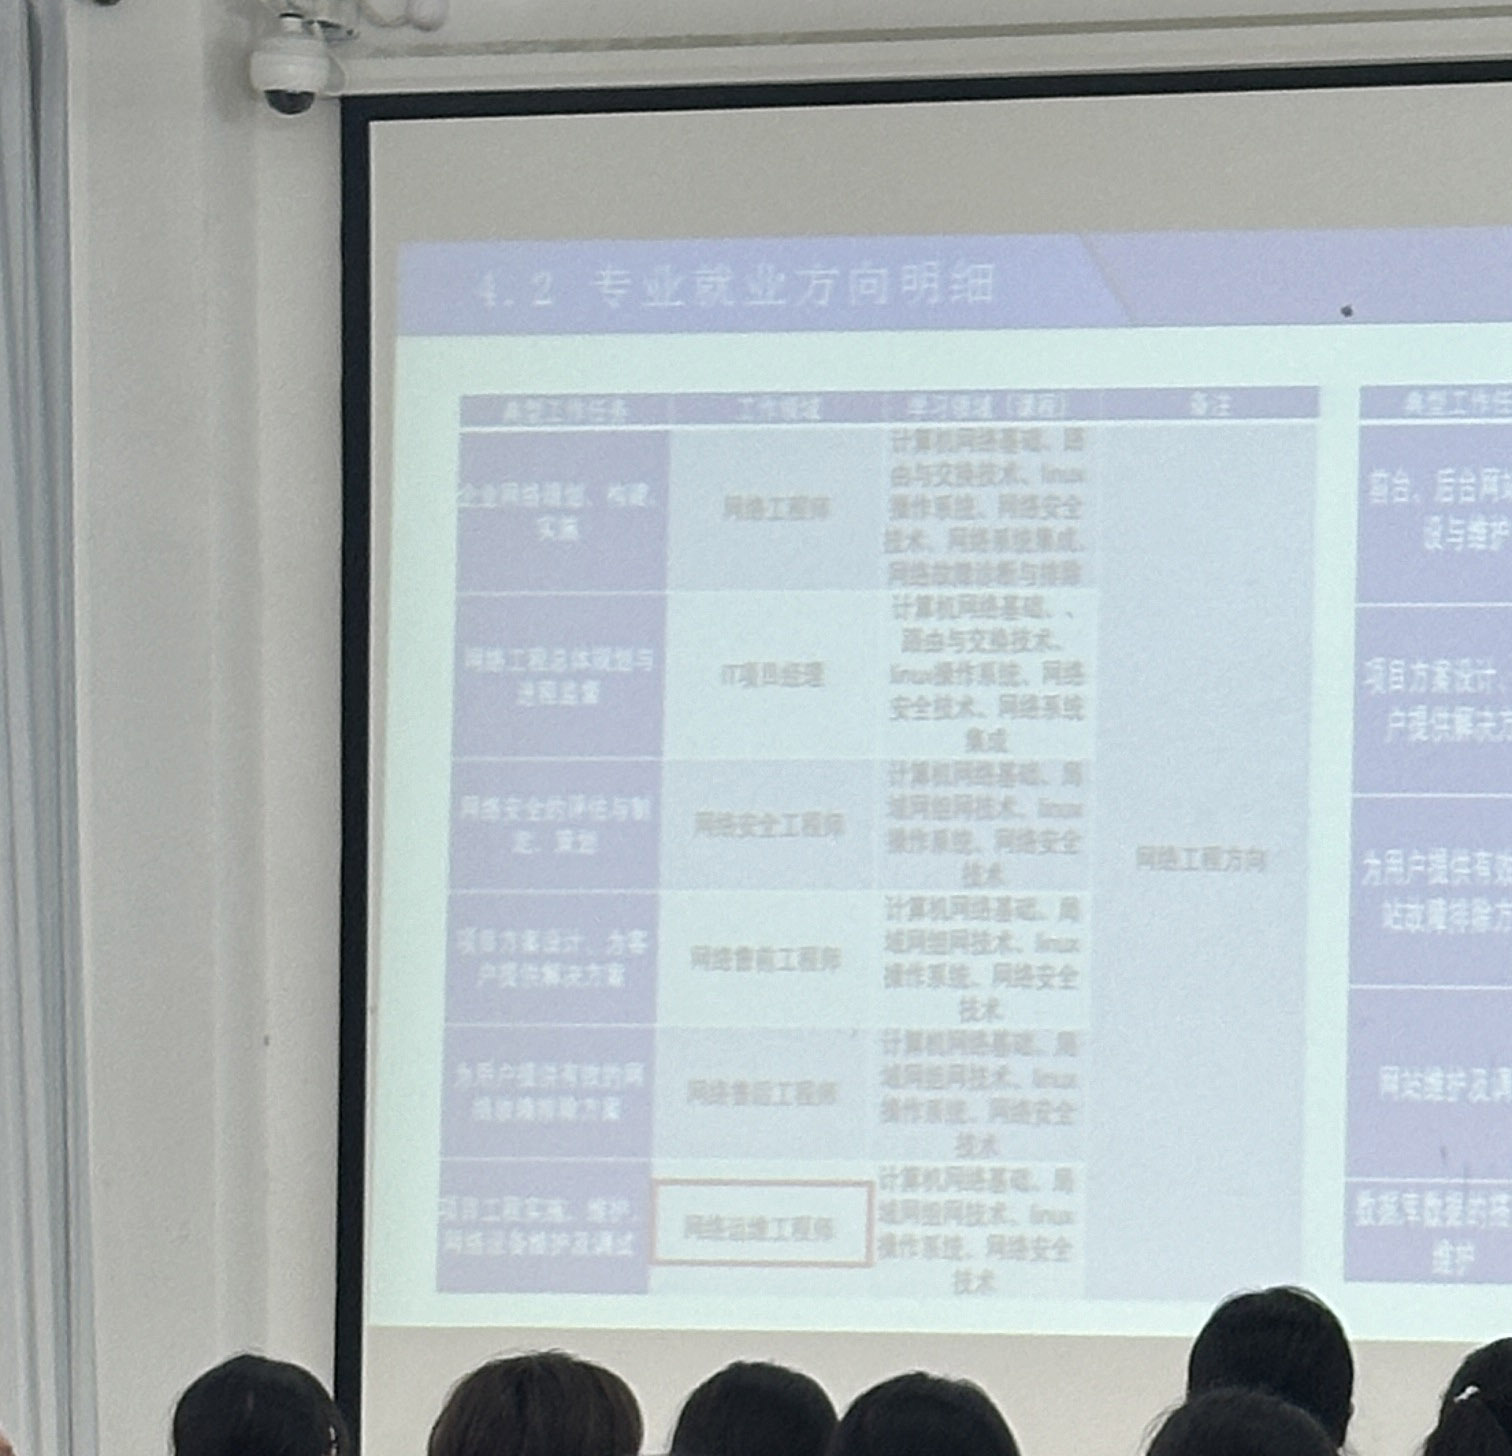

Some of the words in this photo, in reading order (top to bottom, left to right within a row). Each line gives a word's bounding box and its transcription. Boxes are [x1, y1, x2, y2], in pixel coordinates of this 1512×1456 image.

[590, 258, 998, 308] 专业就业方向明细
[694, 811, 845, 840] 网络安全工程师
[1136, 845, 1268, 874] 网络工程方向
[883, 962, 1079, 991] 操作系统、网络安全
[958, 996, 1003, 1024] 技术
